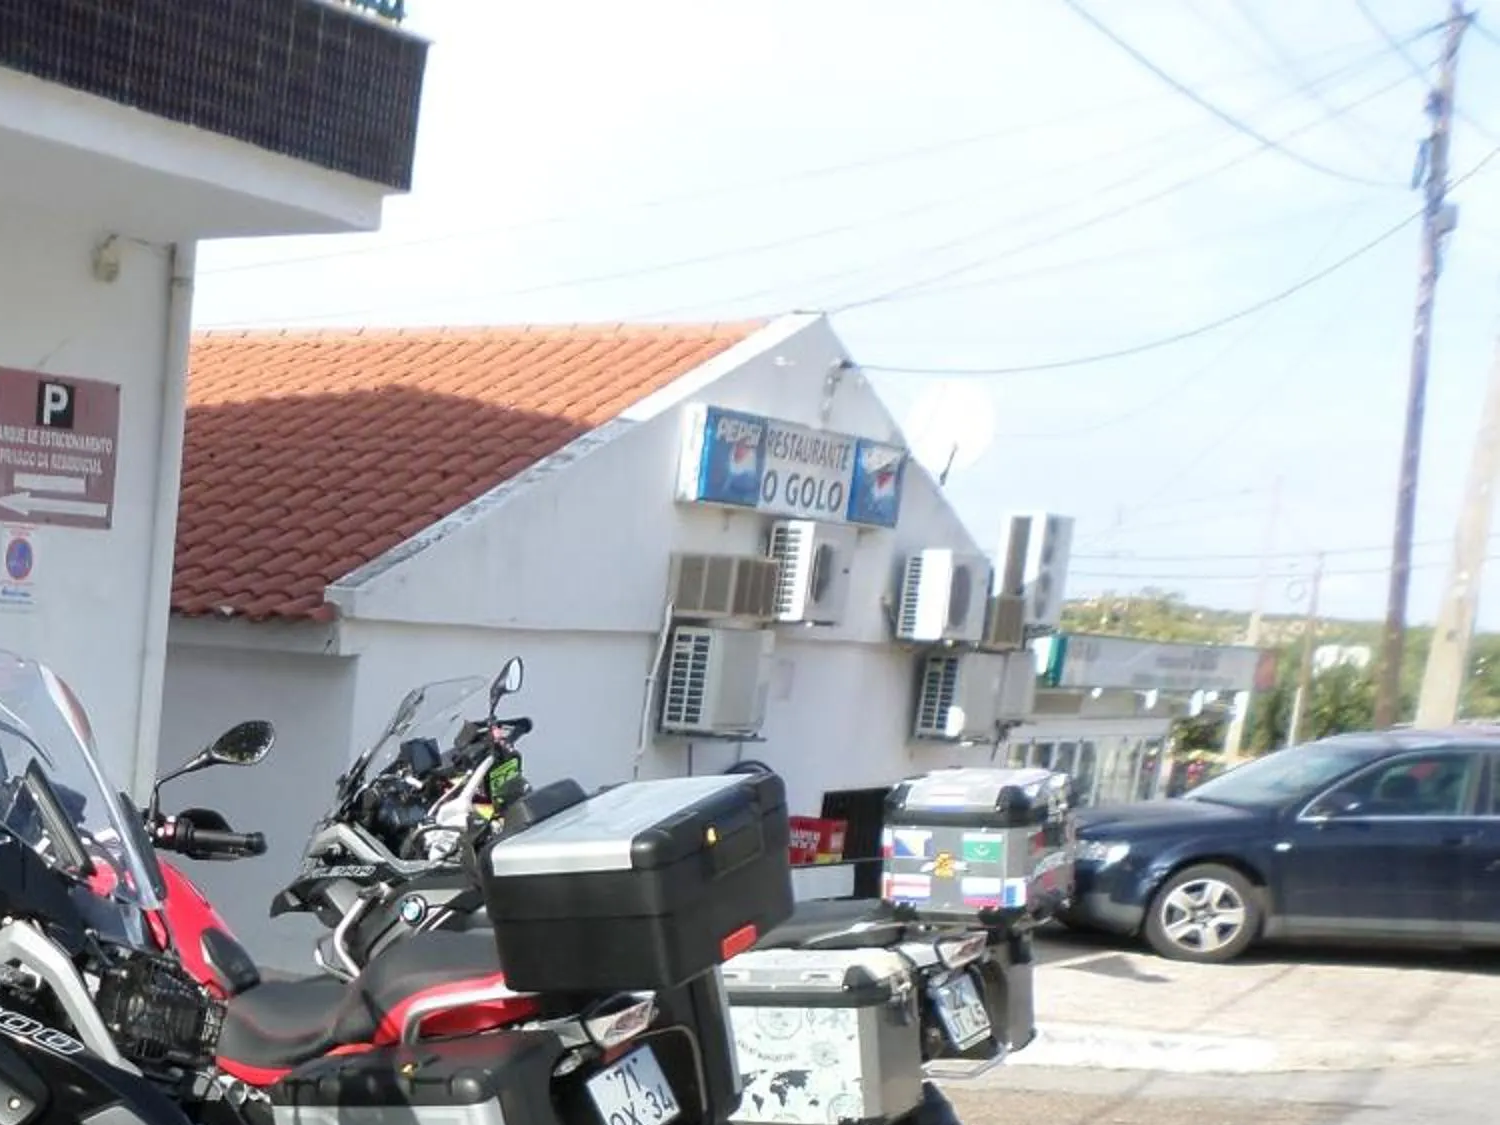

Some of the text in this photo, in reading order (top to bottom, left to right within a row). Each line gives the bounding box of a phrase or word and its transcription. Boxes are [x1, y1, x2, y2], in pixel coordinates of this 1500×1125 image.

[43, 383, 69, 425] P
[766, 429, 852, 473] RESTAURANTE
[762, 470, 843, 512] O GOLO
[613, 1063, 642, 1099] 71
